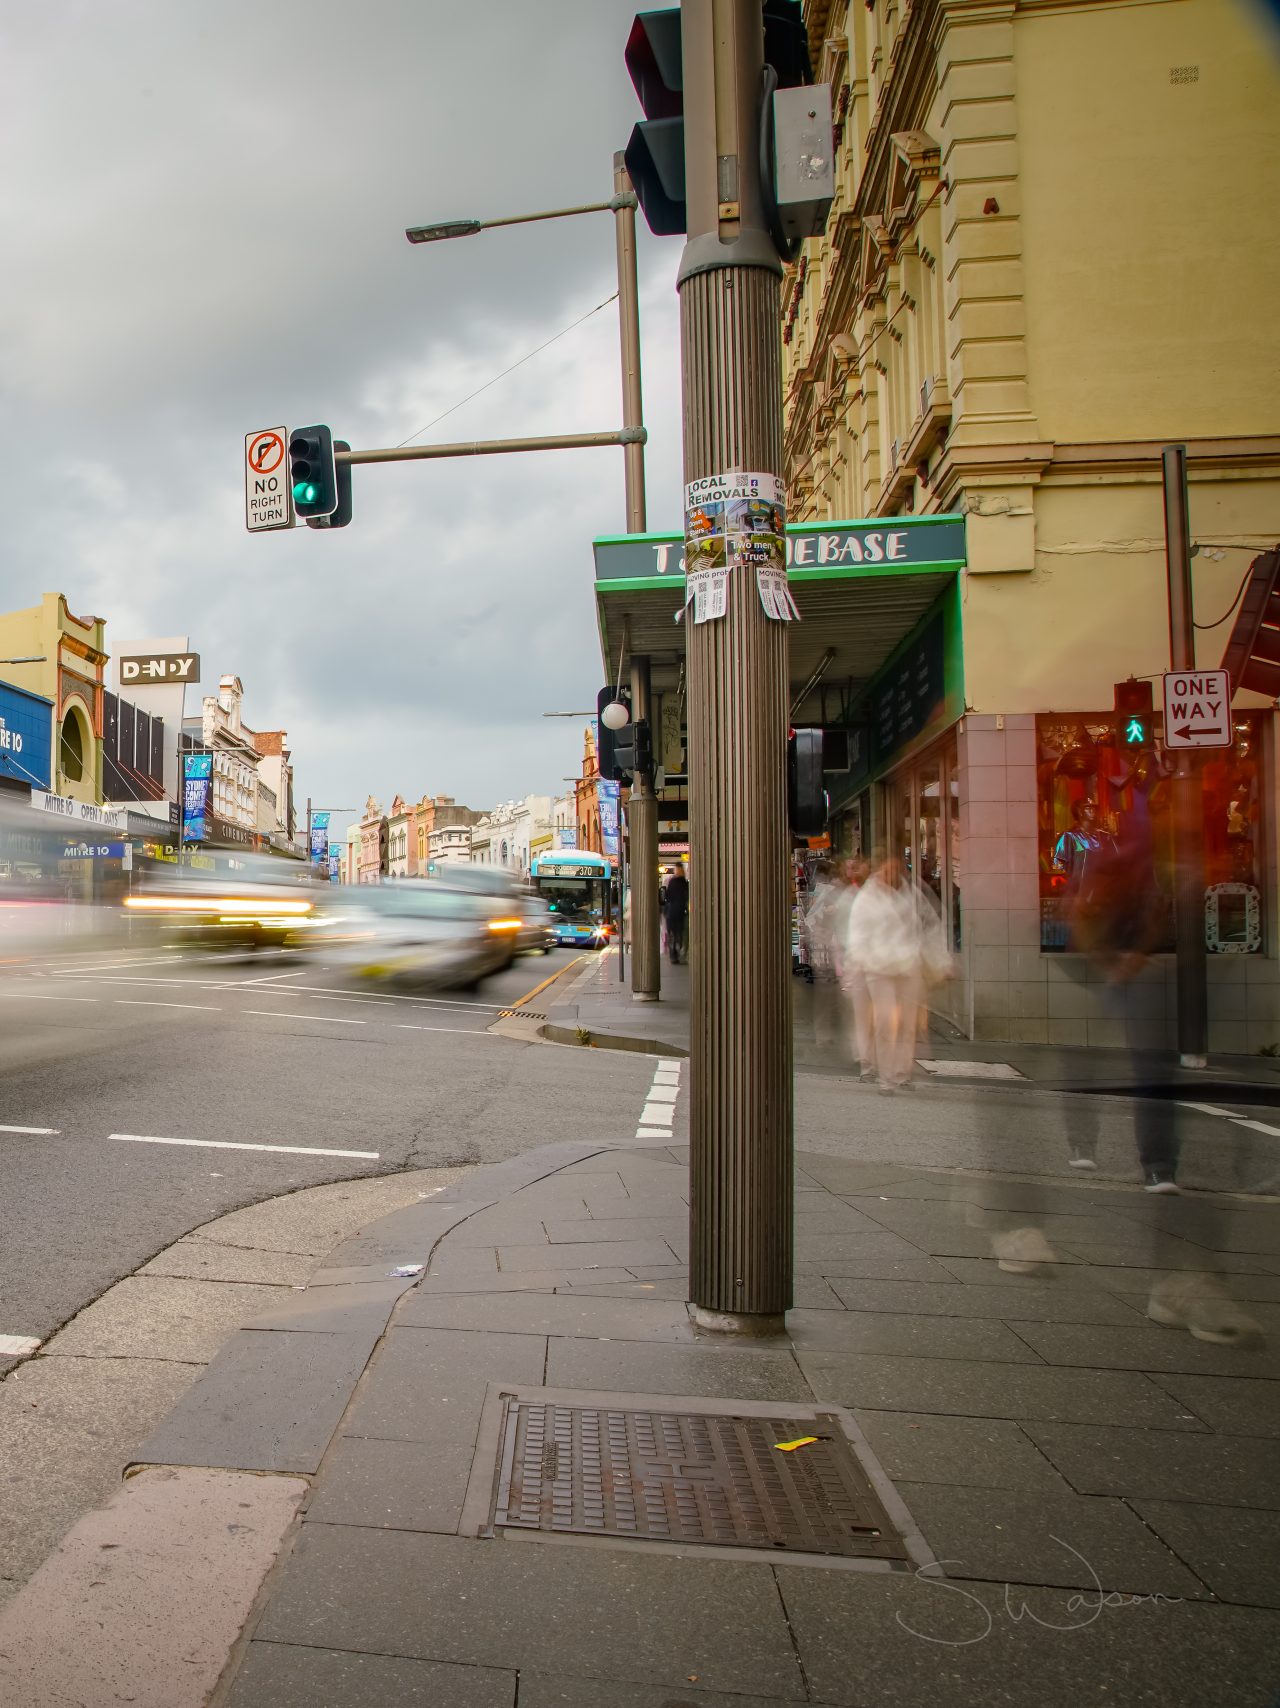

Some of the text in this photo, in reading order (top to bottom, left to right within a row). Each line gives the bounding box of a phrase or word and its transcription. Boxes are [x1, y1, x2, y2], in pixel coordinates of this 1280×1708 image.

[255, 477, 278, 495] NO
[688, 476, 726, 496] LOCAL
[250, 494, 283, 509] RIGHT
[688, 488, 759, 507] REMOVALS
[252, 509, 283, 523] TURN
[731, 541, 772, 550] Two men
[733, 552, 769, 561] & Truck
[122, 658, 194, 679] DENDY
[1173, 678, 1218, 696] ONE
[1170, 701, 1222, 720] WAY
[12, 732, 23, 753] 10
[44, 795, 64, 814] MITRE
[65, 800, 73, 816] 10
[80, 805, 98, 823] OPEN
[98, 809, 103, 823] 7
[104, 811, 119, 828] DAYS
[96, 846, 109, 856] 10
[579, 866, 593, 876] 370
